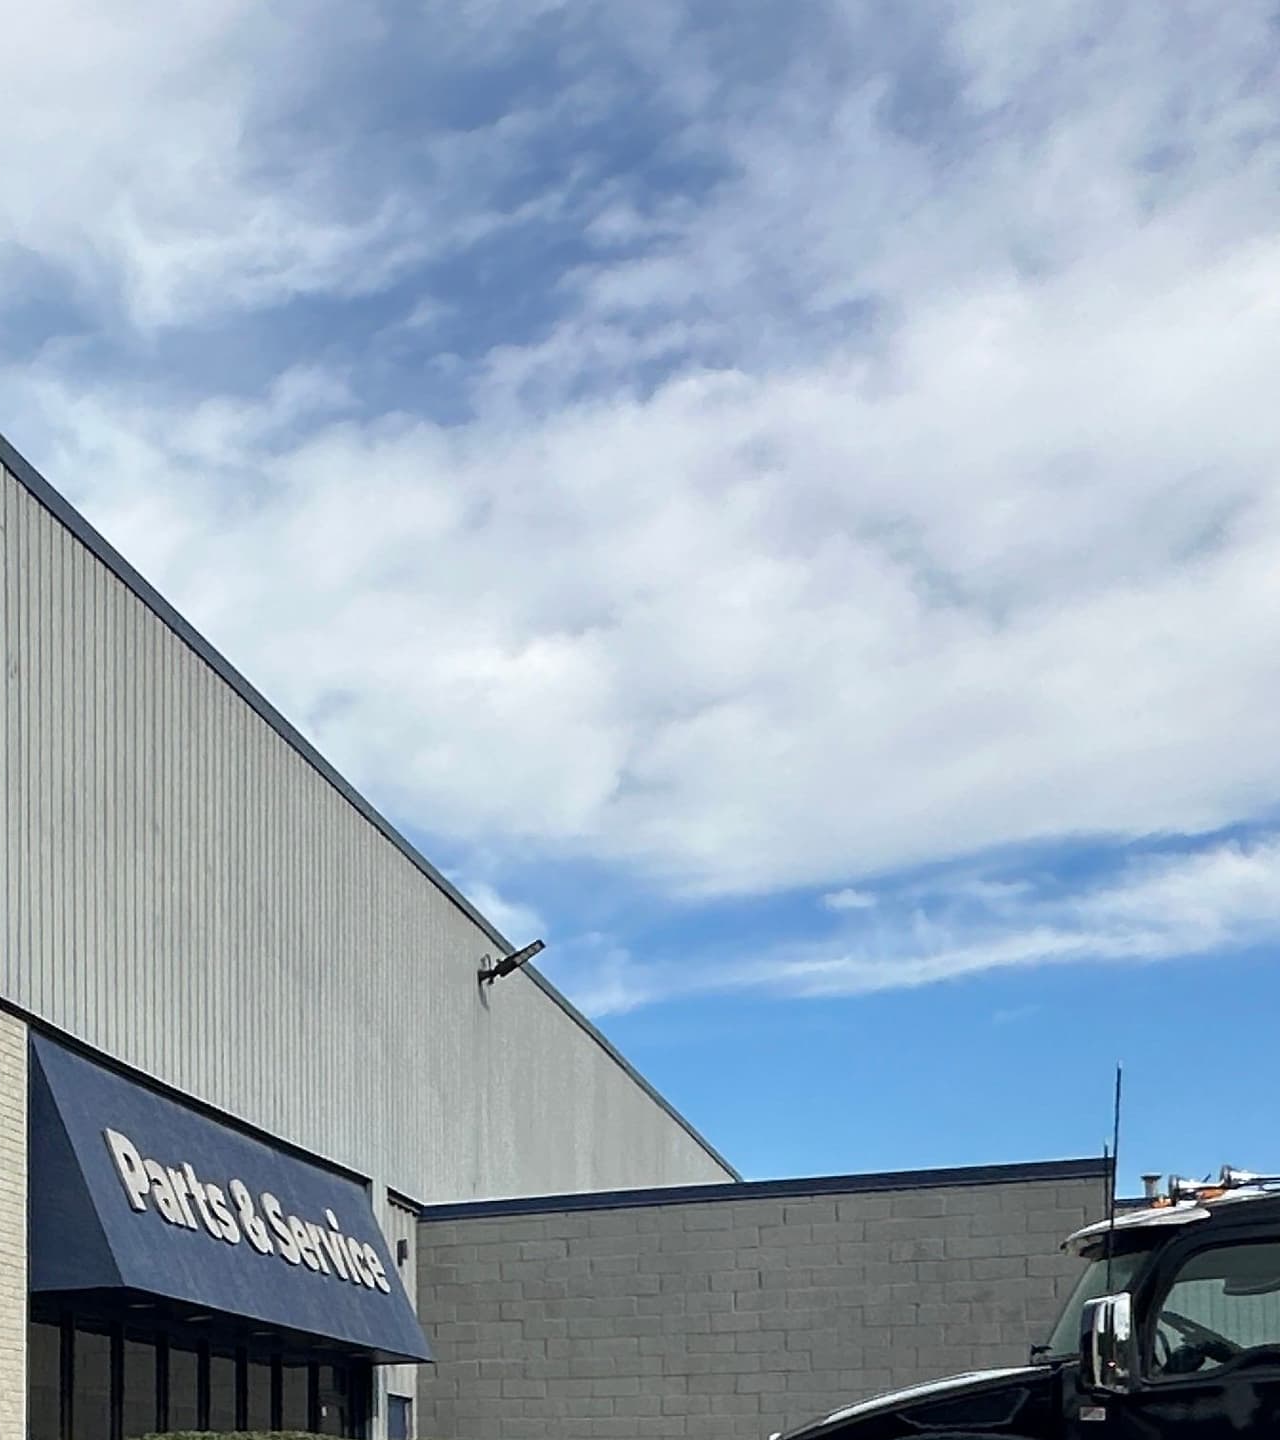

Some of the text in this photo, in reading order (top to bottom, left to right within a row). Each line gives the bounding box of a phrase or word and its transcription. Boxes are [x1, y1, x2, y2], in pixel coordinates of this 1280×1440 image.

[104, 1127, 390, 1294] Parts & Service
